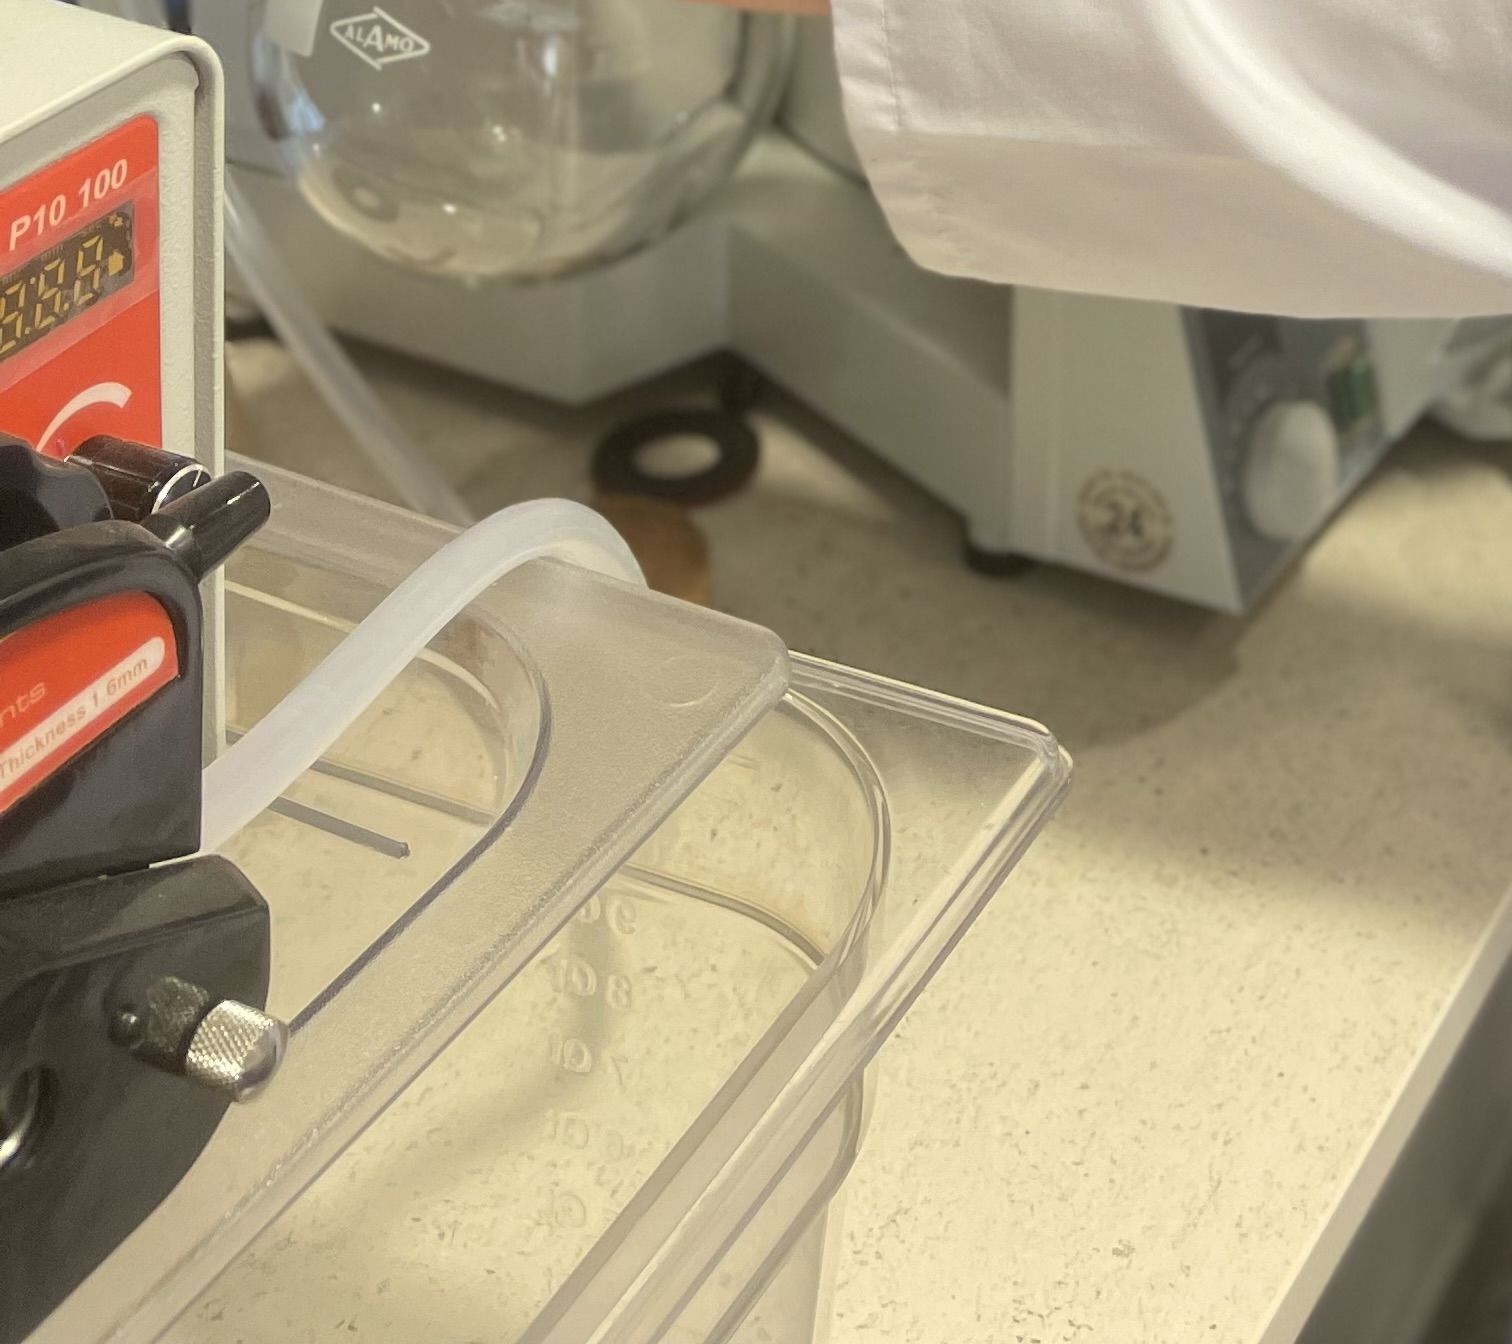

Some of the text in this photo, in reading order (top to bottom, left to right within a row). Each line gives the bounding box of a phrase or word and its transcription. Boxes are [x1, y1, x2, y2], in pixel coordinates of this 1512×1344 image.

[344, 23, 415, 54] ALAMO
[9, 158, 129, 252] P10 100
